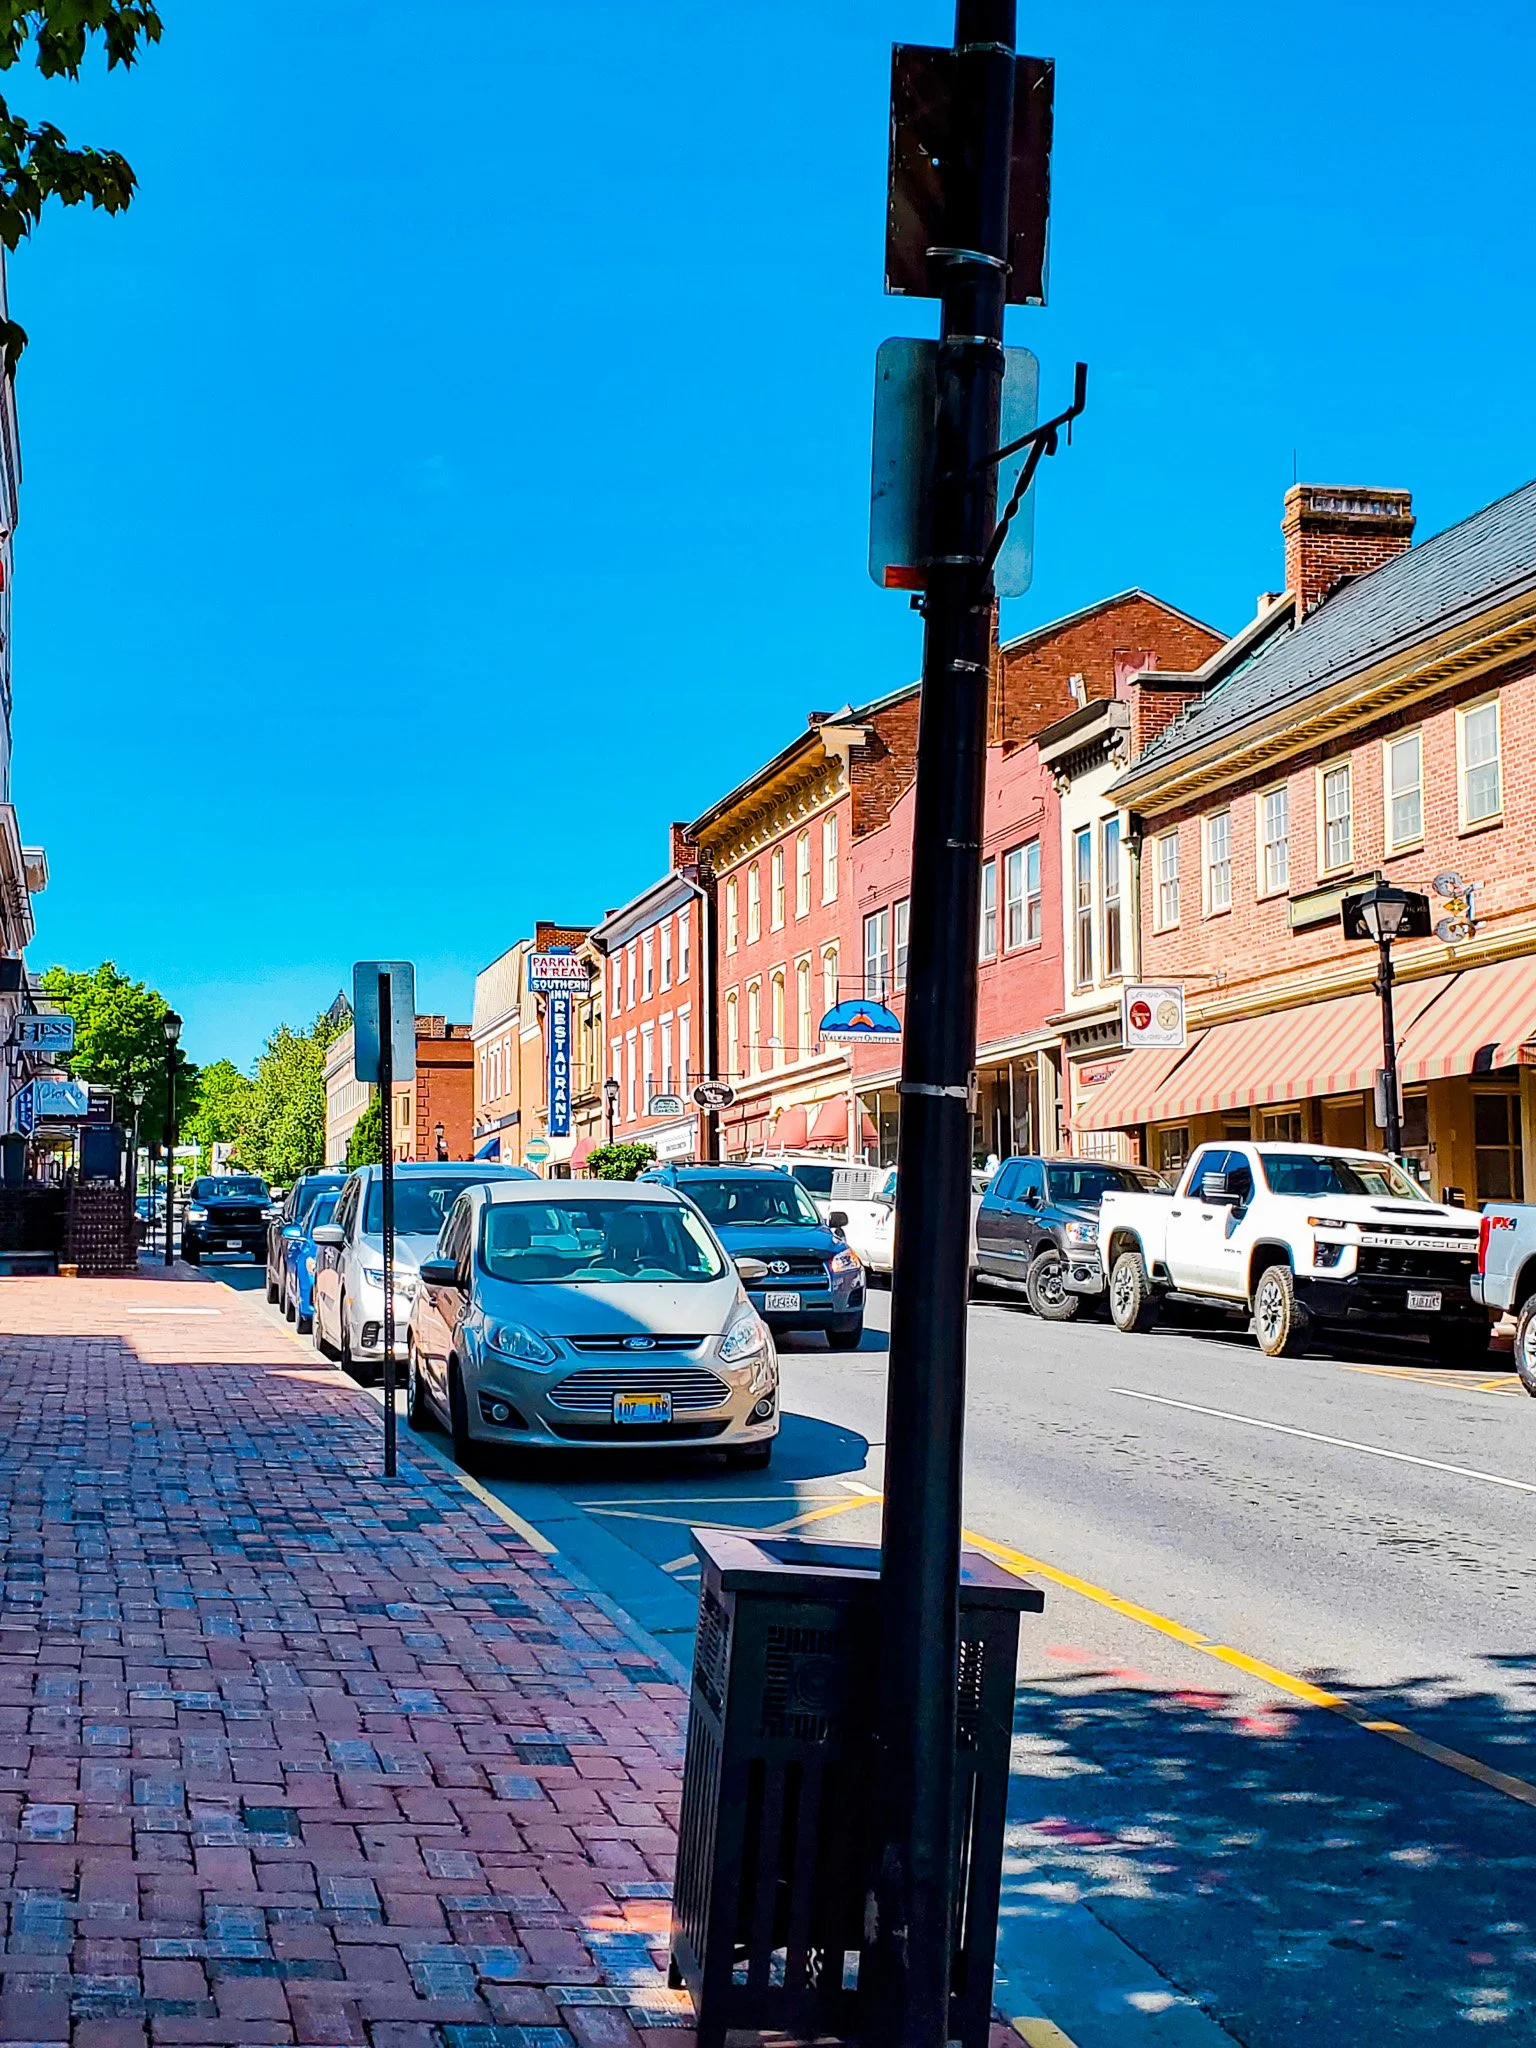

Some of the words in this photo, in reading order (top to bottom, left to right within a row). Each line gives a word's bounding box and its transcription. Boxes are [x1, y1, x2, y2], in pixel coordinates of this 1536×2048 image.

[535, 967, 548, 977] IN
[552, 967, 587, 977] REAR
[532, 980, 588, 990] SOUTHERN
[550, 990, 570, 1000] INN
[18, 1022, 72, 1042] HESS
[554, 1000, 567, 1127] RESTAURANT
[1492, 1216, 1518, 1230] FX4
[1360, 1236, 1478, 1251] CHEVROLET
